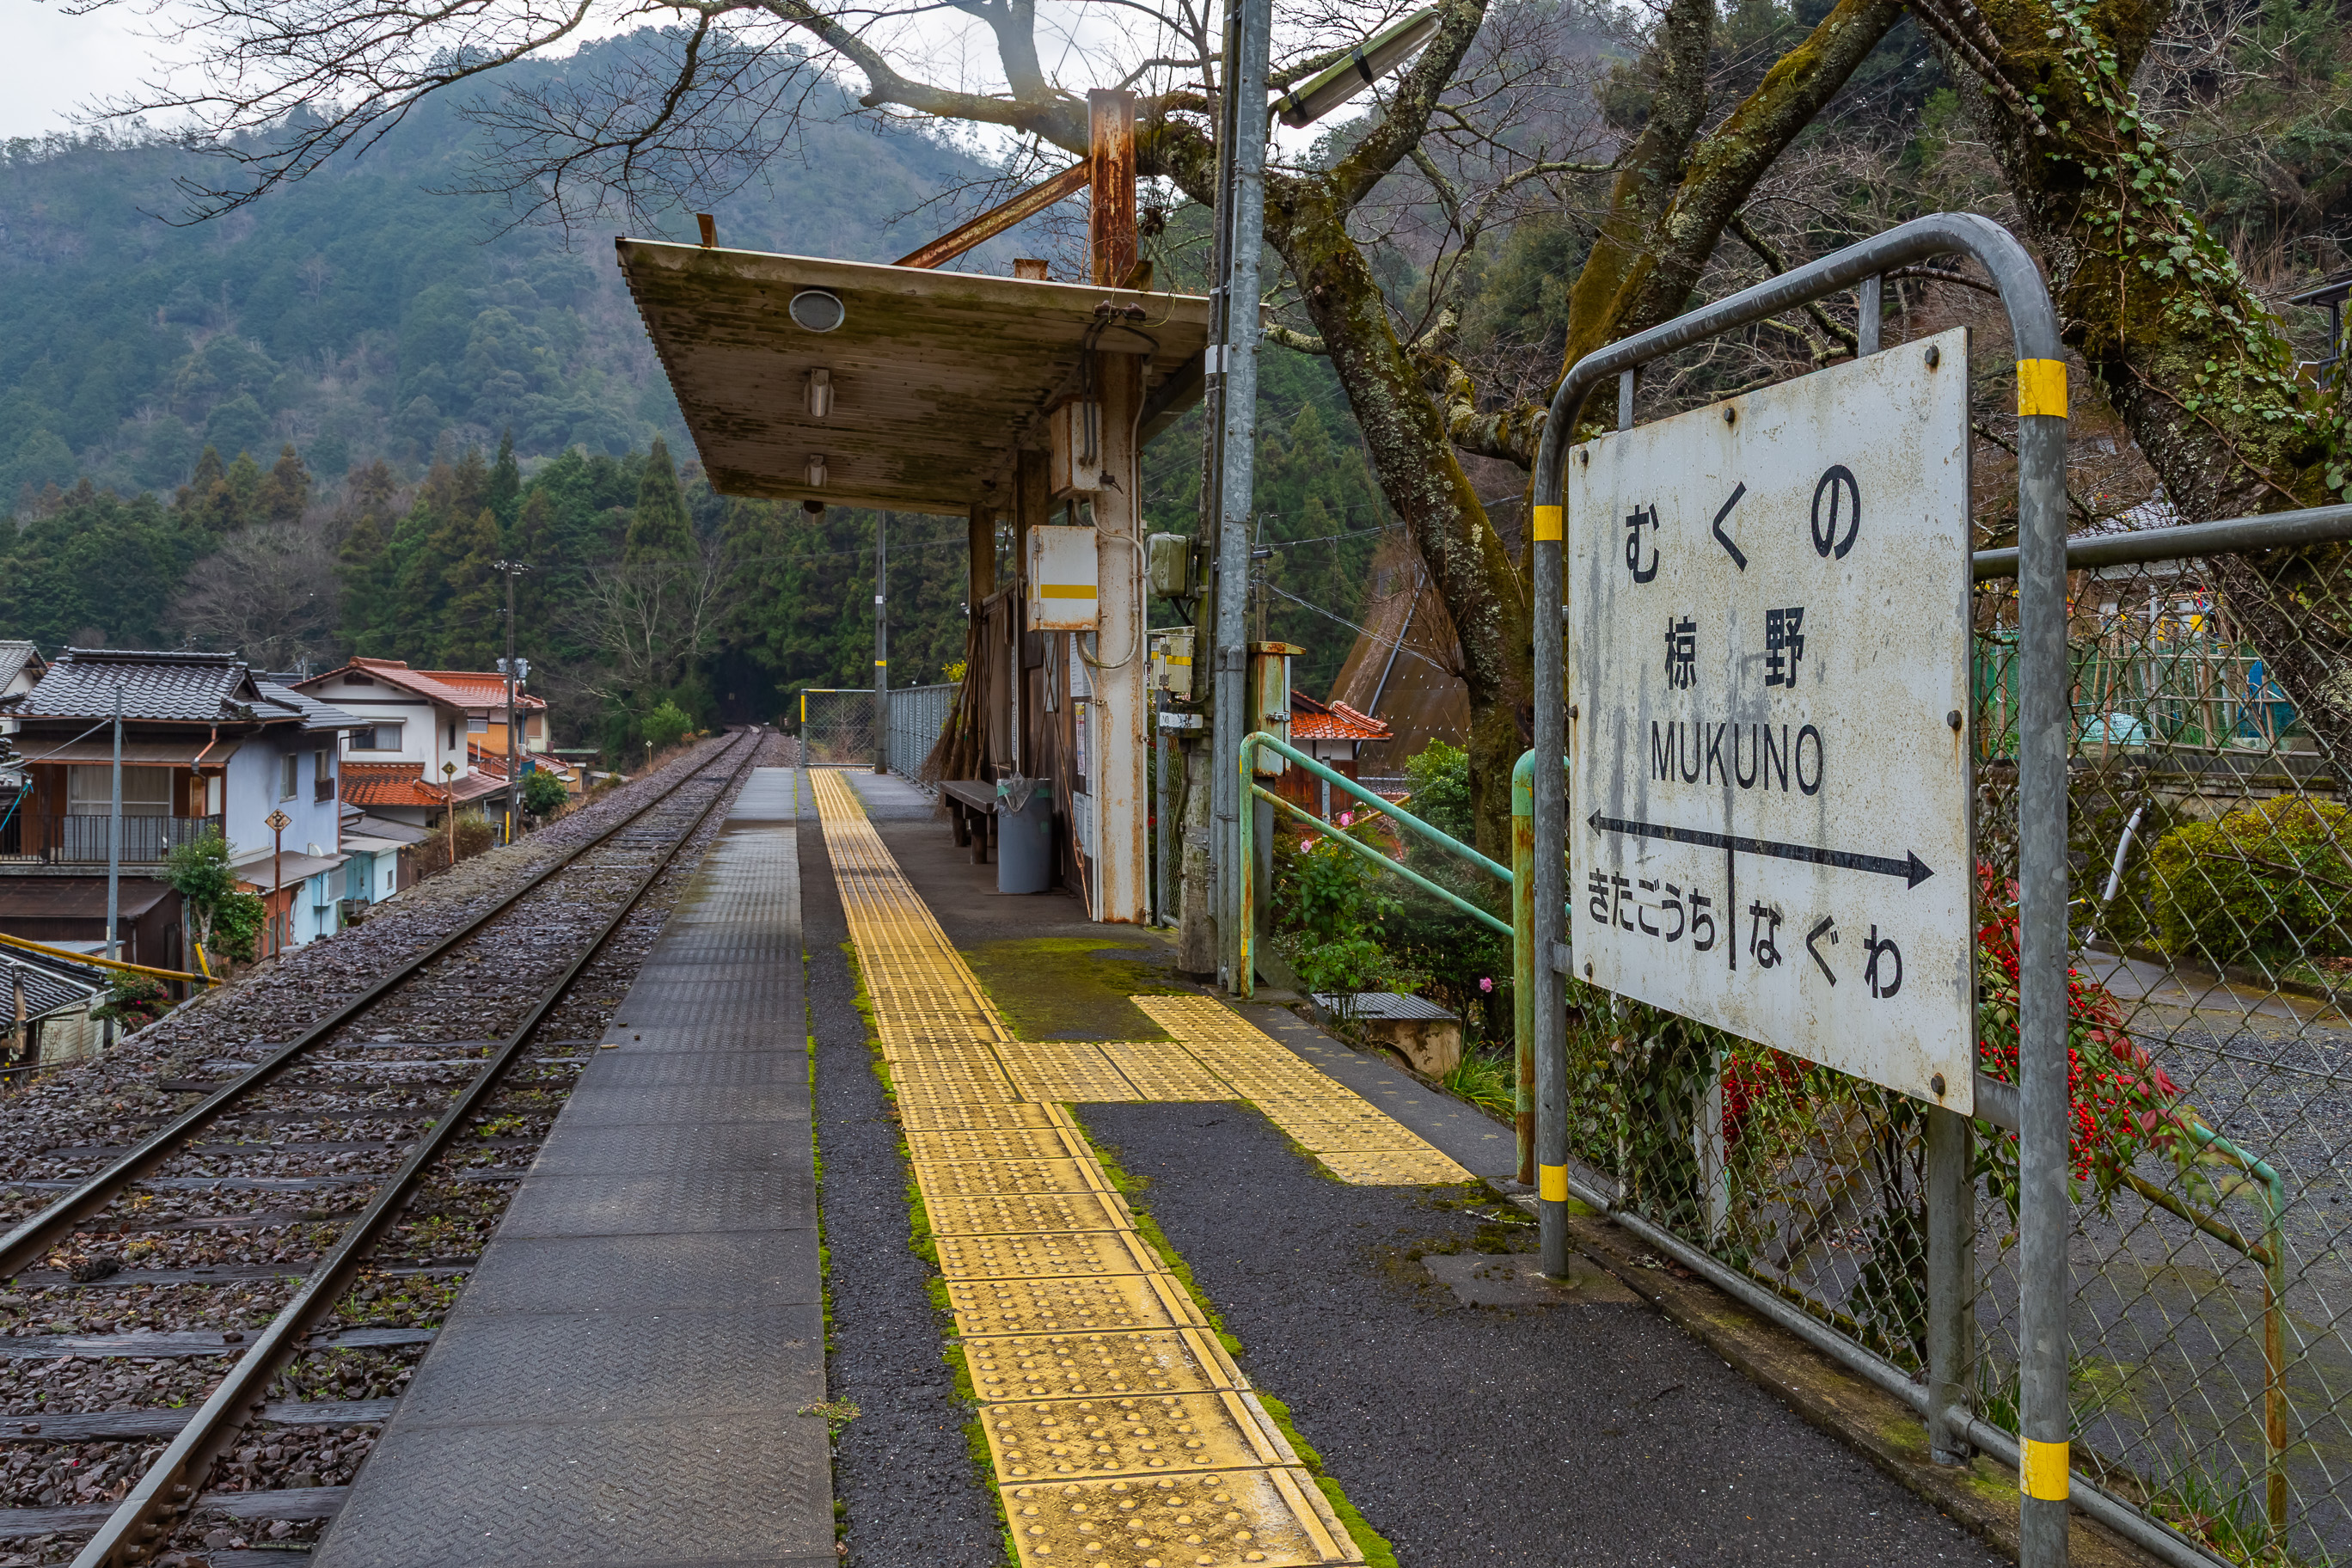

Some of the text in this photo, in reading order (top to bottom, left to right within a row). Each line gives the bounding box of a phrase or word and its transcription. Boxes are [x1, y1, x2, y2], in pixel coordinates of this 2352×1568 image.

[1626, 464, 1861, 584] むくの
[1664, 607, 1804, 689] 椋野
[1651, 720, 1823, 796] MUKUNO
[1588, 867, 1716, 952] きたごうち
[1749, 899, 1903, 1000] なぐわ
